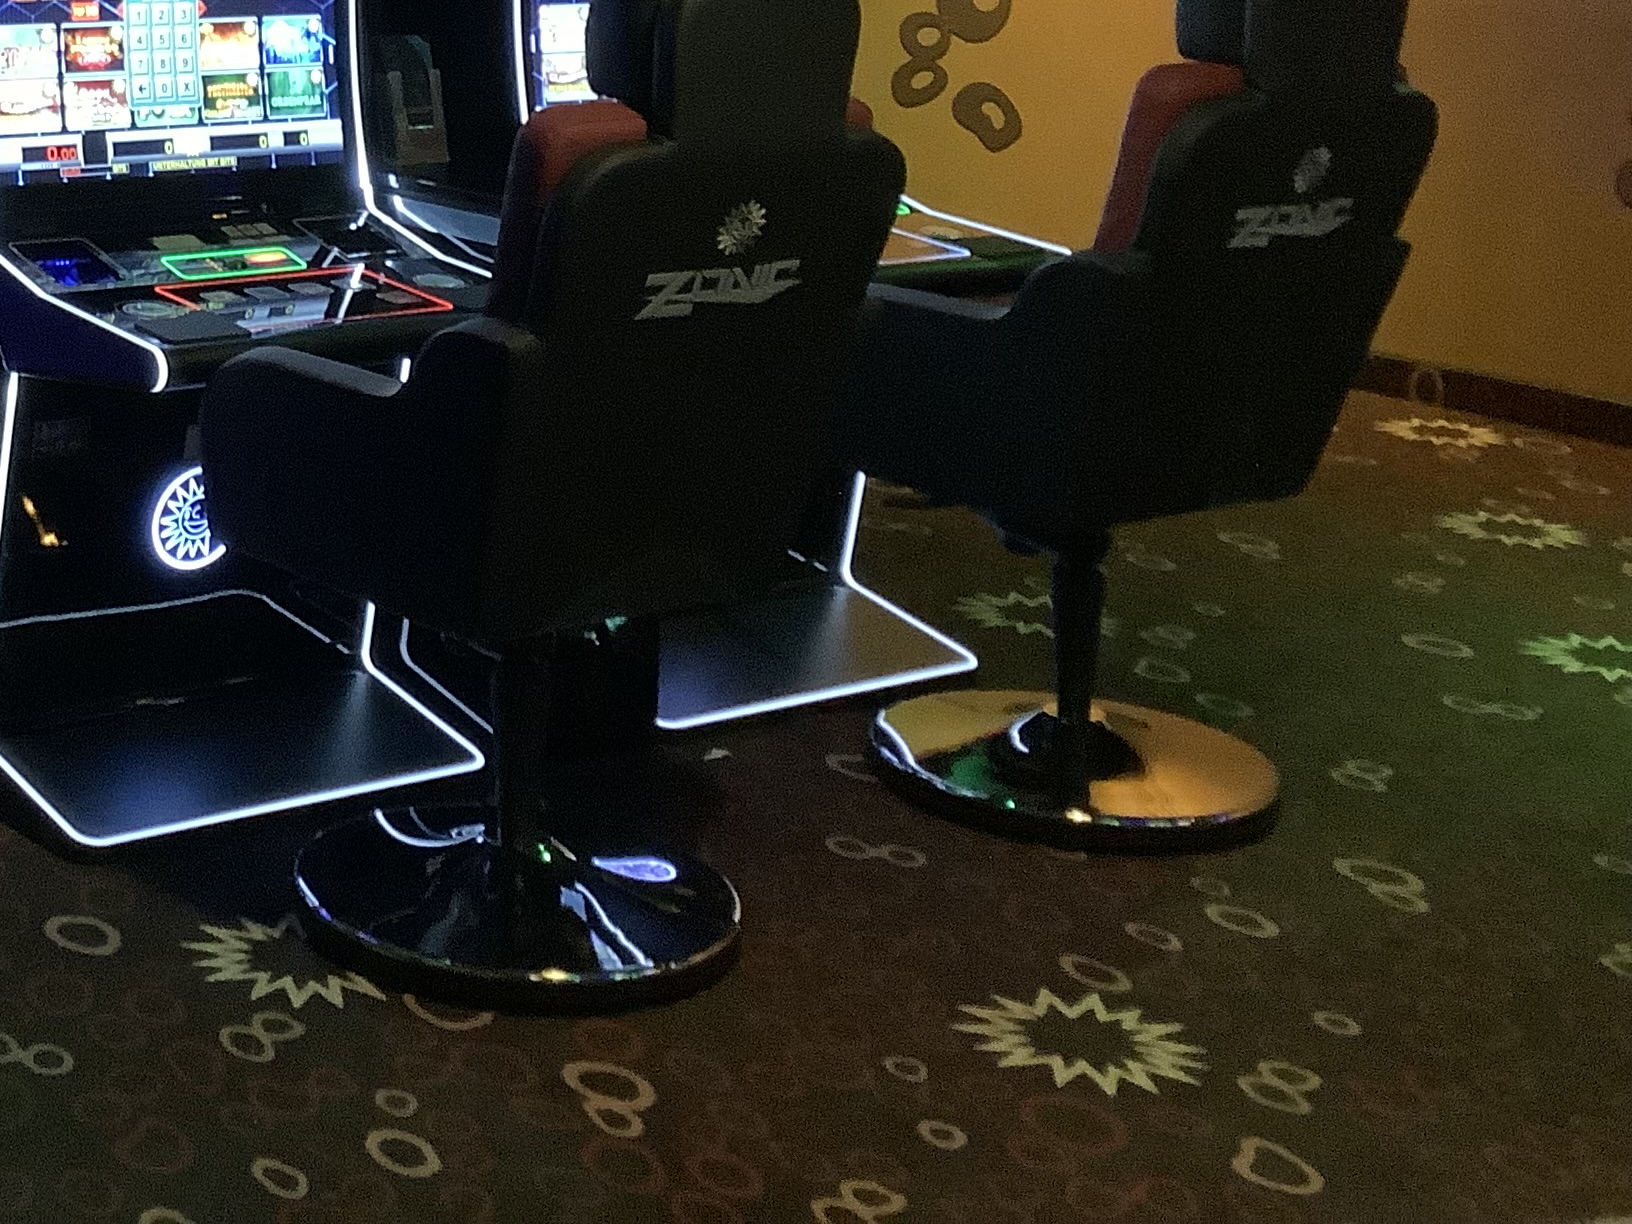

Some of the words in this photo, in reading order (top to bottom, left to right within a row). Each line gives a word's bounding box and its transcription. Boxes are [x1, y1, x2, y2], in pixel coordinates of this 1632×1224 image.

[258, 135, 268, 149] 0
[299, 133, 308, 146] 0
[164, 140, 174, 155] 0
